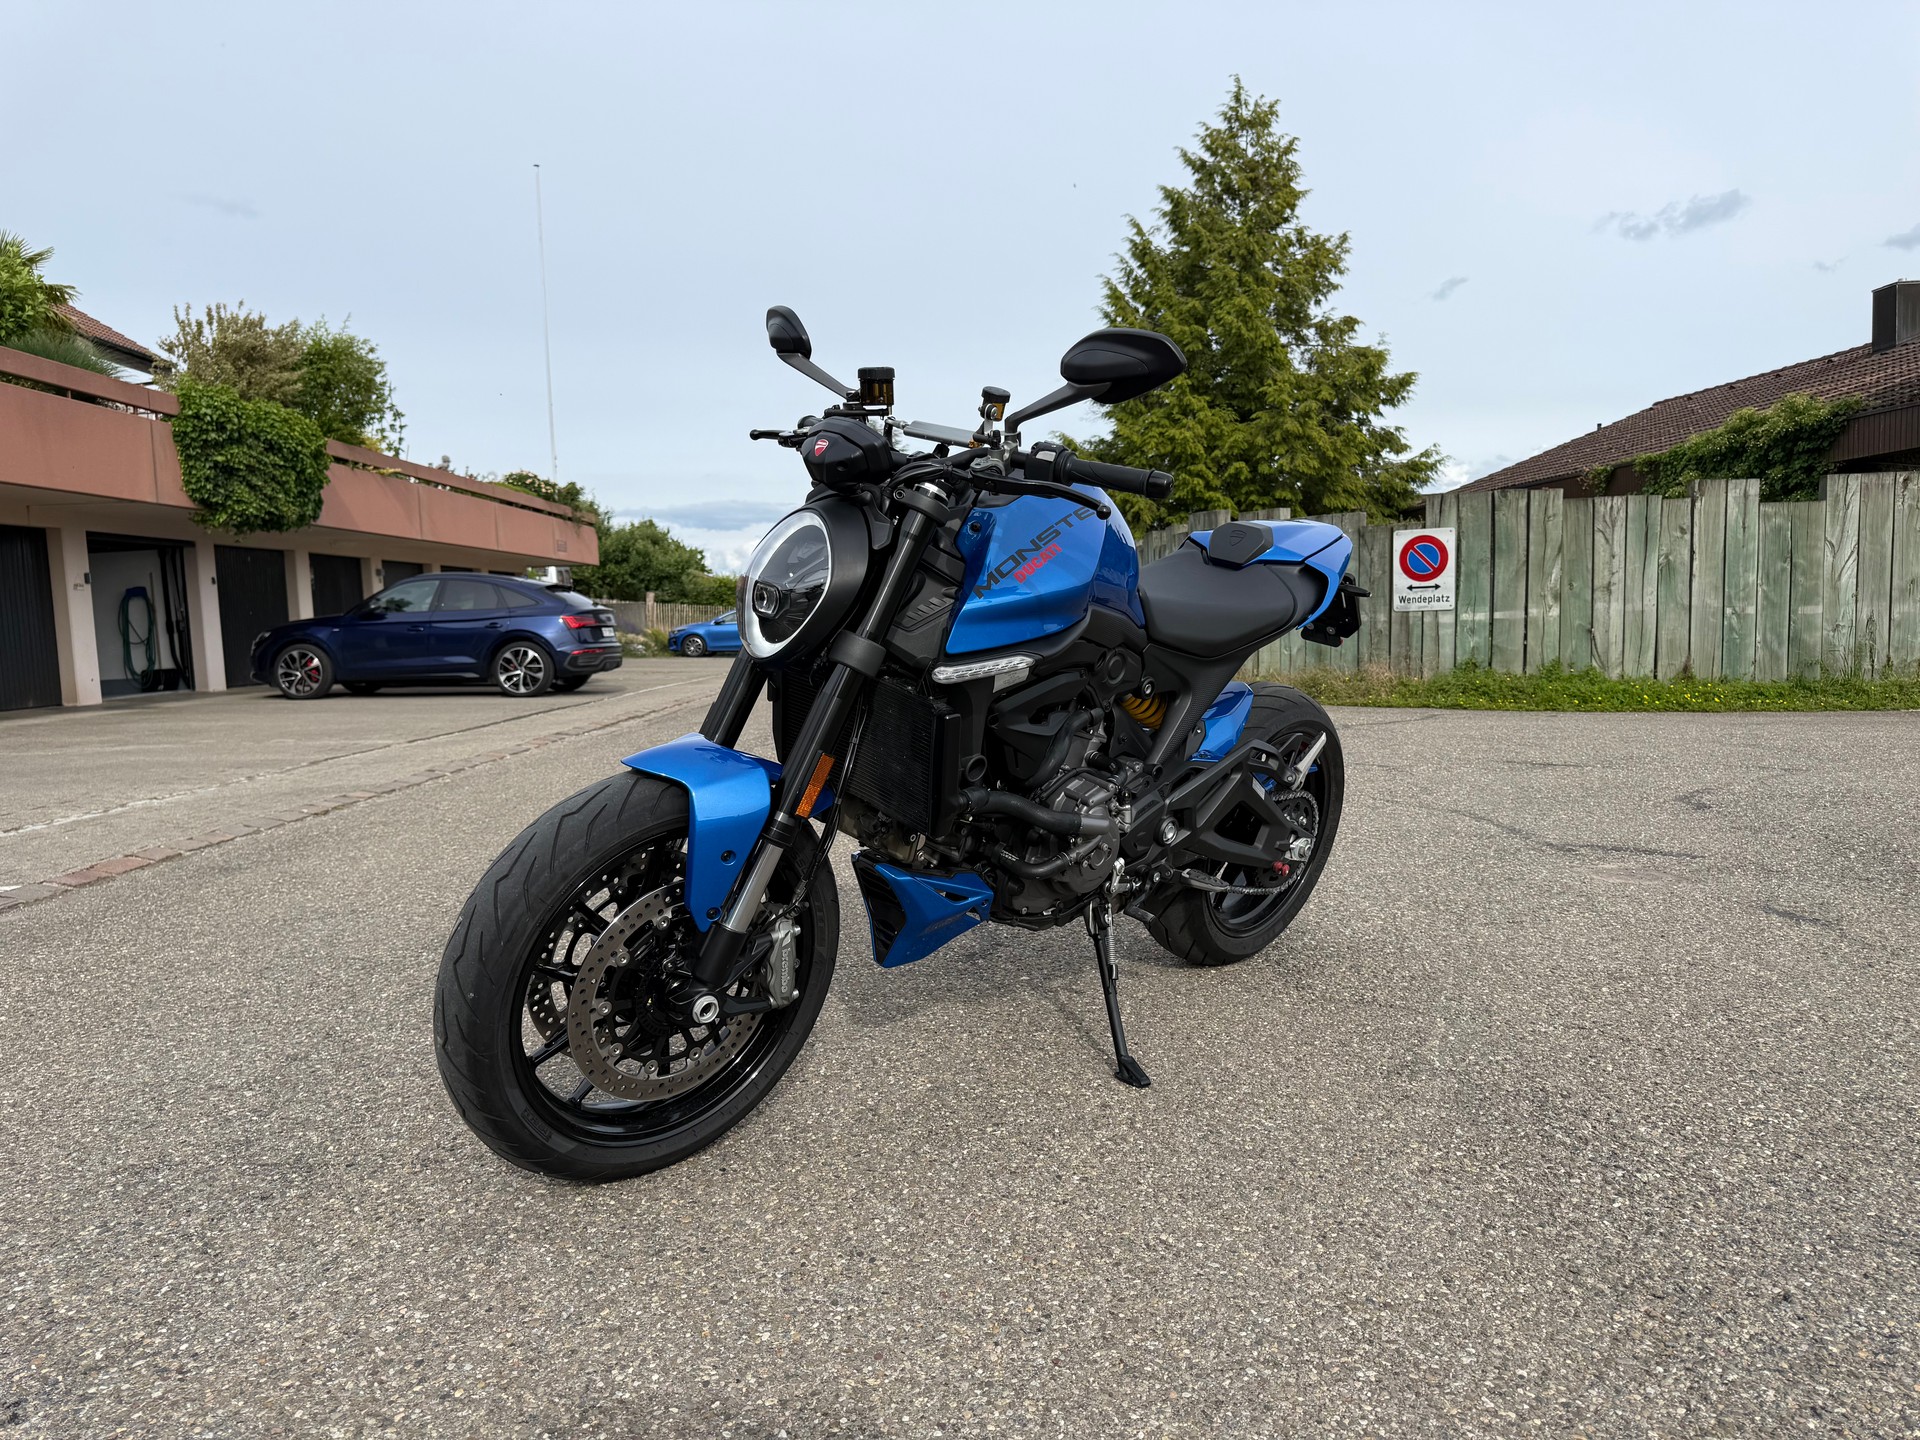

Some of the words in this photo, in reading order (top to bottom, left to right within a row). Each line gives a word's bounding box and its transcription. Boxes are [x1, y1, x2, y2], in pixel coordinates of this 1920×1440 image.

[973, 507, 1096, 600] MONSTE
[1013, 543, 1062, 584] DUCATI
[1398, 594, 1450, 605] Wendeplatz
[781, 947, 791, 993] brembo
